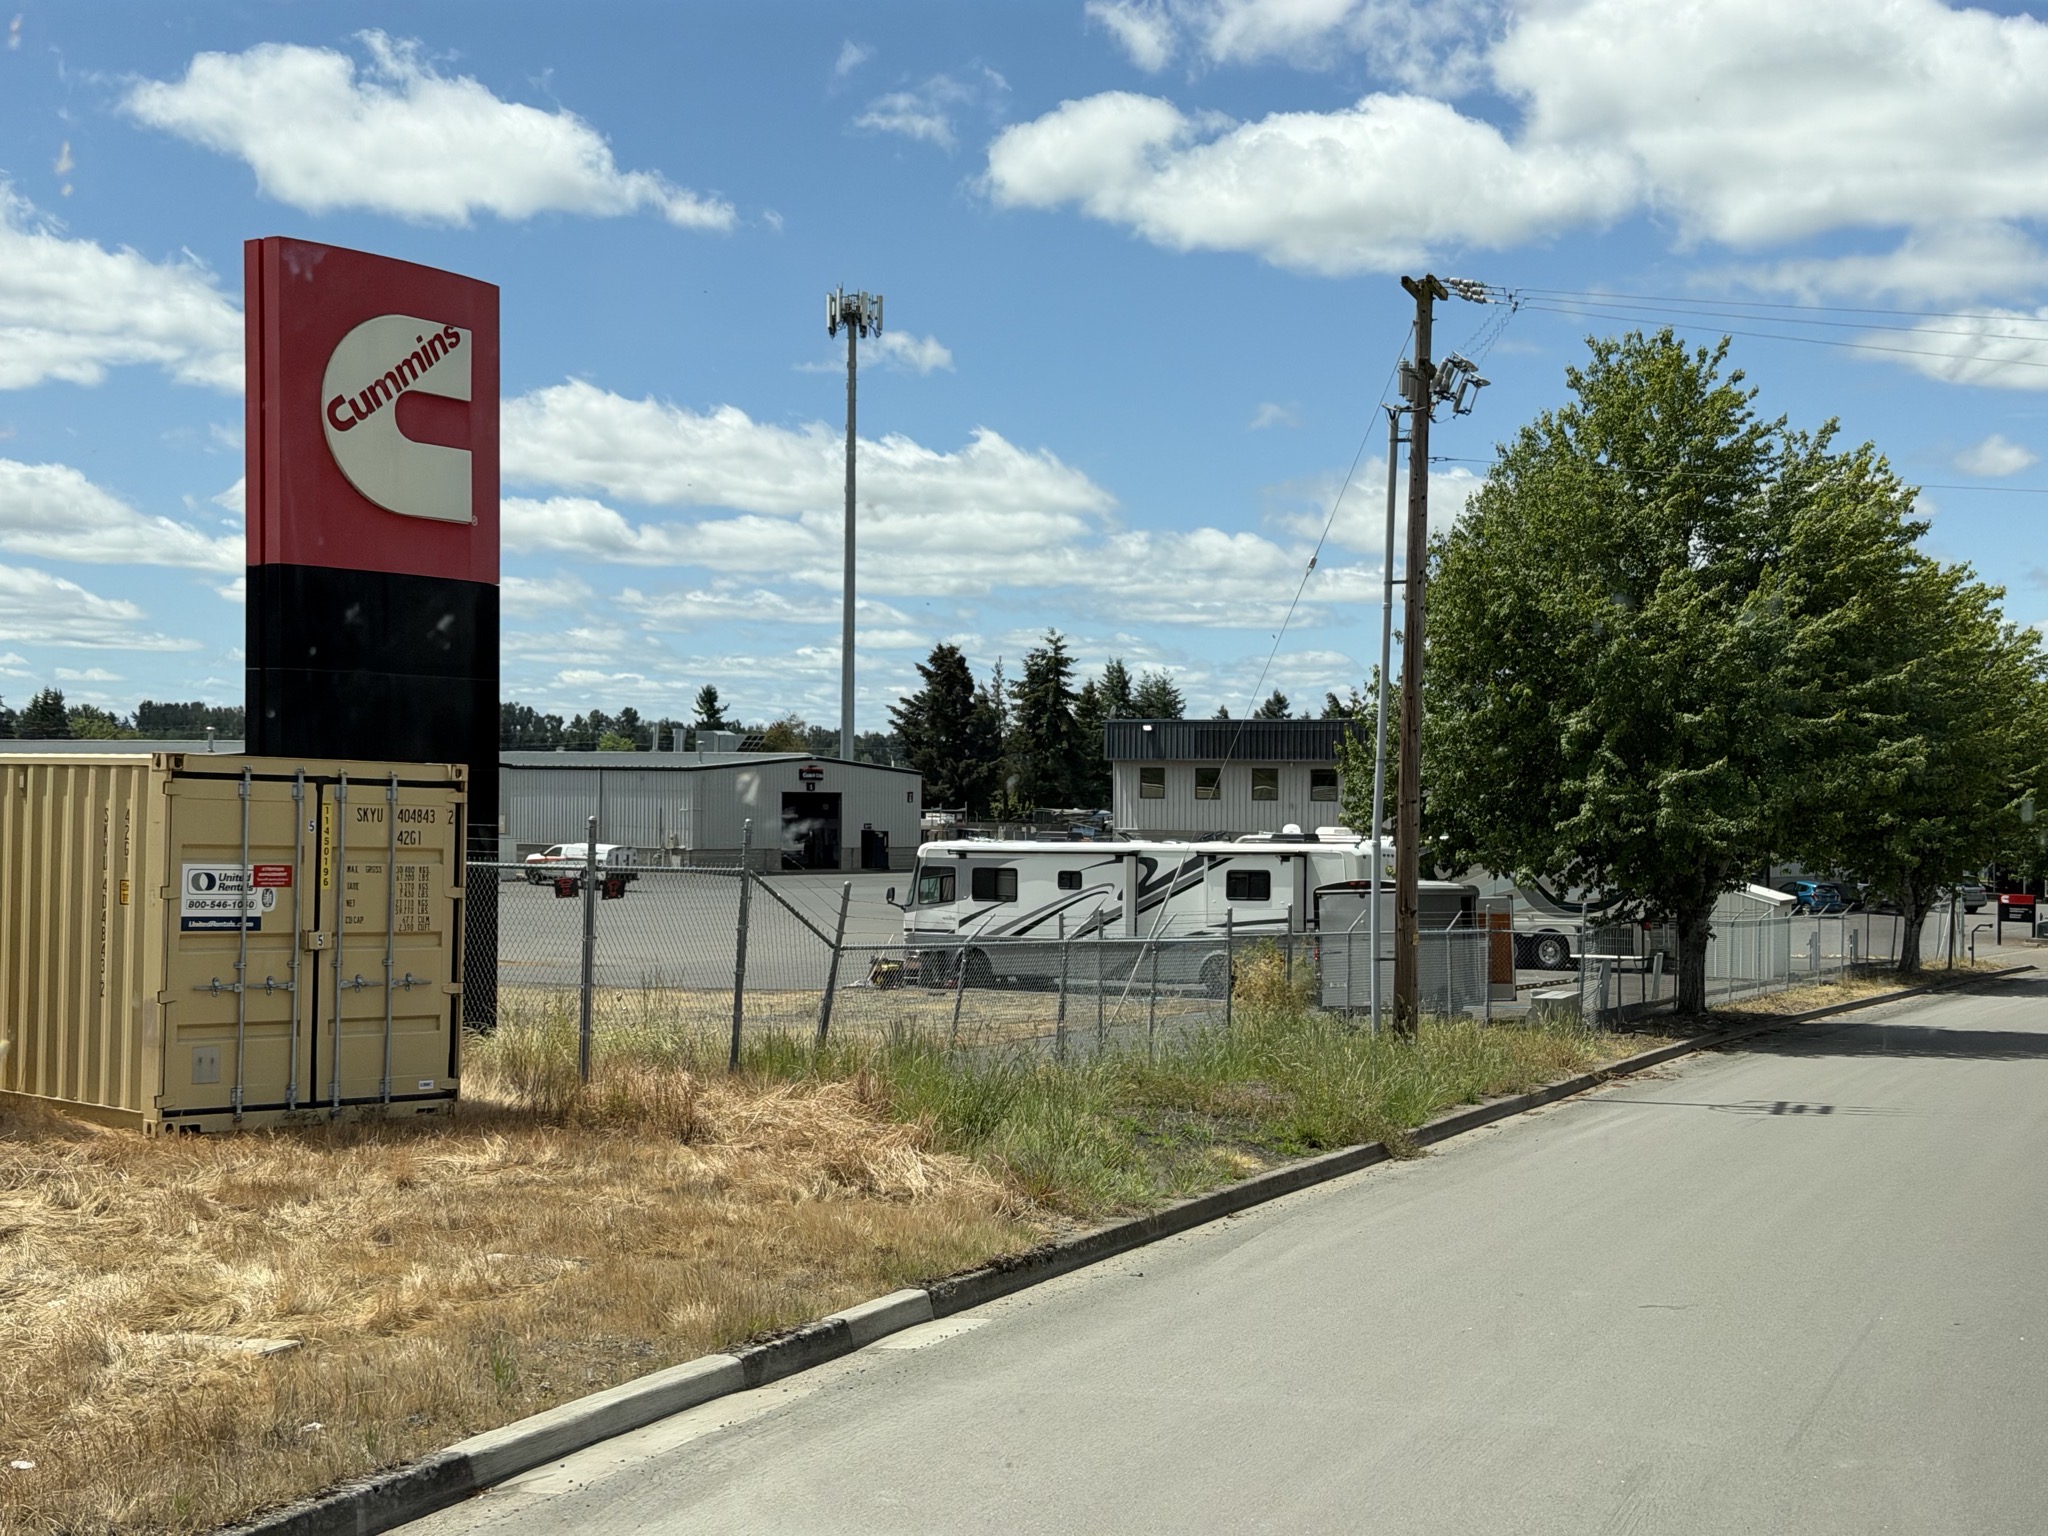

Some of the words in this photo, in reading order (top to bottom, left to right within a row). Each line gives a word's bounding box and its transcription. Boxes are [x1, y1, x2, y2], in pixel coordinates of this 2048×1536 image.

[326, 325, 461, 432] Cummins
[356, 808, 384, 823] SKYU
[397, 809, 436, 824] 404843
[447, 810, 454, 825] 2
[309, 821, 315, 832] 5
[397, 831, 422, 846] 42G1
[218, 872, 252, 882] United
[317, 935, 324, 946] 5
